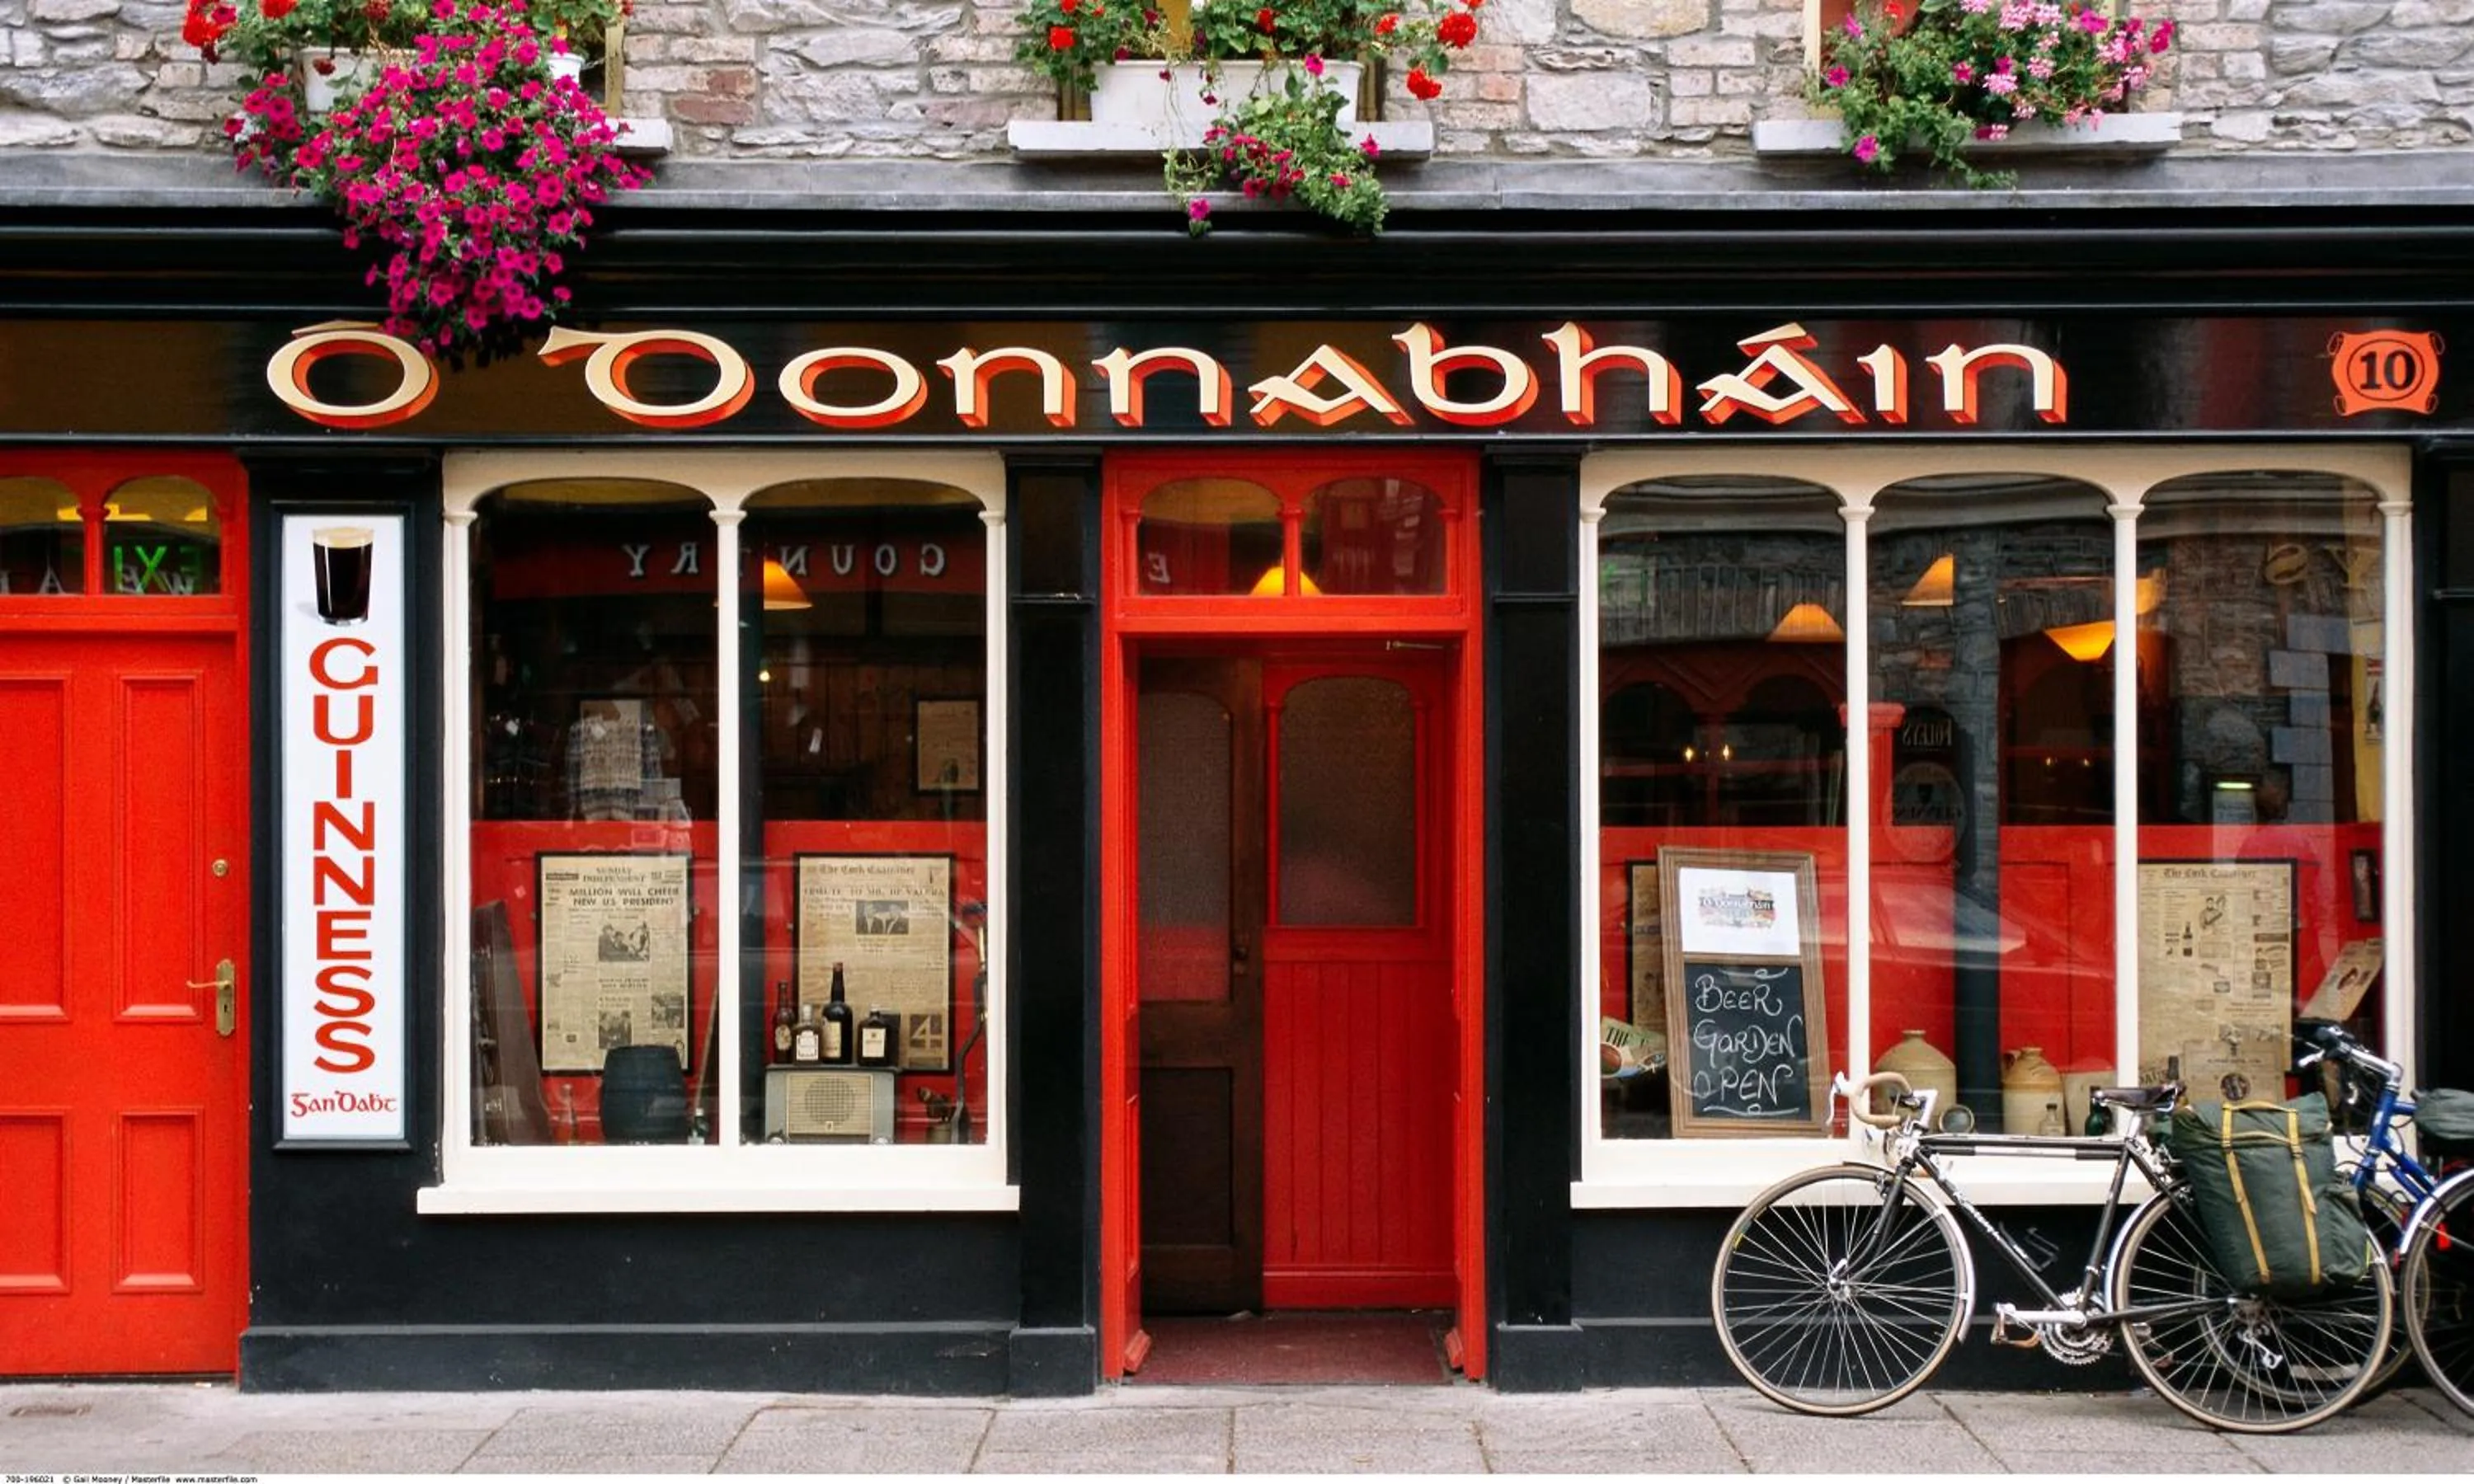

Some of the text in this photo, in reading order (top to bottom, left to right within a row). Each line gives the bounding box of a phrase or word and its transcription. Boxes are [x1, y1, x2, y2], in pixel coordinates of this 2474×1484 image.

[2359, 349, 2417, 391] 10
[308, 636, 379, 1074] GUINNESS
[573, 898, 596, 906] NEW
[1693, 1064, 1794, 1106] OPEN
